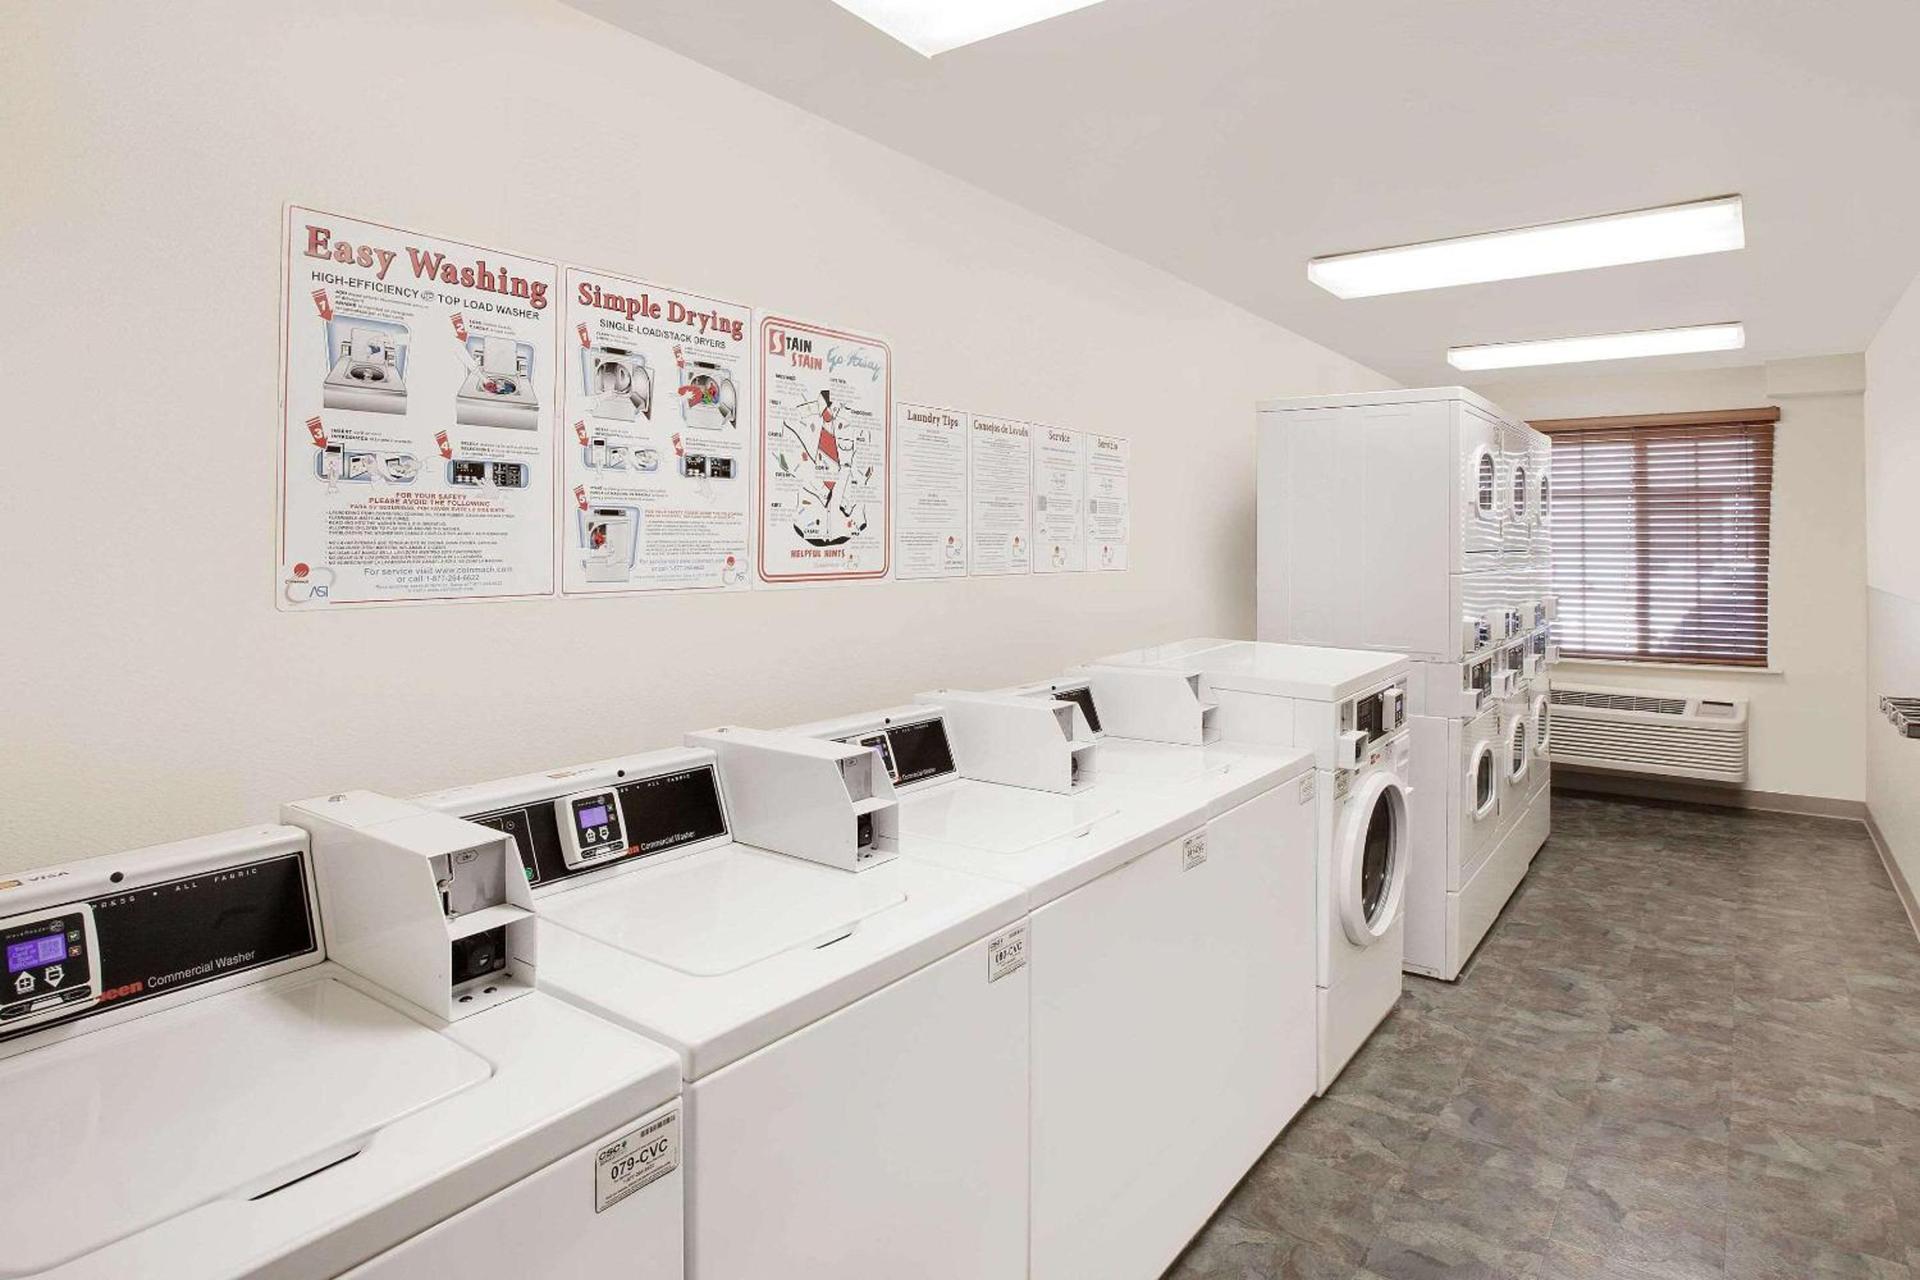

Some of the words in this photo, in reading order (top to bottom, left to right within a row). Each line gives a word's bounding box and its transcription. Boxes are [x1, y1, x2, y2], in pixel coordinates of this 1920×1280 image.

[304, 224, 397, 280] Easy
[406, 246, 548, 309] Washing
[311, 270, 420, 300] HIGH-EFFICIENCY
[438, 293, 460, 306] TOP
[463, 299, 494, 313] LOAD
[495, 305, 540, 320] WASHER
[578, 282, 661, 321] Simple
[667, 299, 743, 341] Drying
[694, 336, 726, 349] DRYERS
[769, 328, 812, 356] STAIN
[791, 352, 823, 371] STAIN
[826, 345, 843, 373] Go
[846, 347, 881, 382] Away
[906, 409, 941, 428] Laundry
[942, 414, 959, 429] Tips
[1001, 424, 1009, 434] de
[368, 497, 400, 505] PLEASE
[402, 498, 427, 506] AVOID
[415, 492, 436, 500] YOUR
[791, 549, 821, 558] HELPFUL
[824, 549, 845, 558] HINTS
[364, 567, 380, 576] For
[382, 568, 413, 576] service
[416, 566, 433, 575] visit
[408, 574, 423, 583] call
[309, 585, 329, 598] ASI
[28, 870, 69, 882] VISA
[175, 881, 199, 893] ALL
[214, 867, 258, 884] FABRIC
[147, 962, 214, 989] Commercial
[215, 950, 256, 969] Washer
[598, 1143, 621, 1162] CSC
[610, 1138, 669, 1180] 079-CVC
